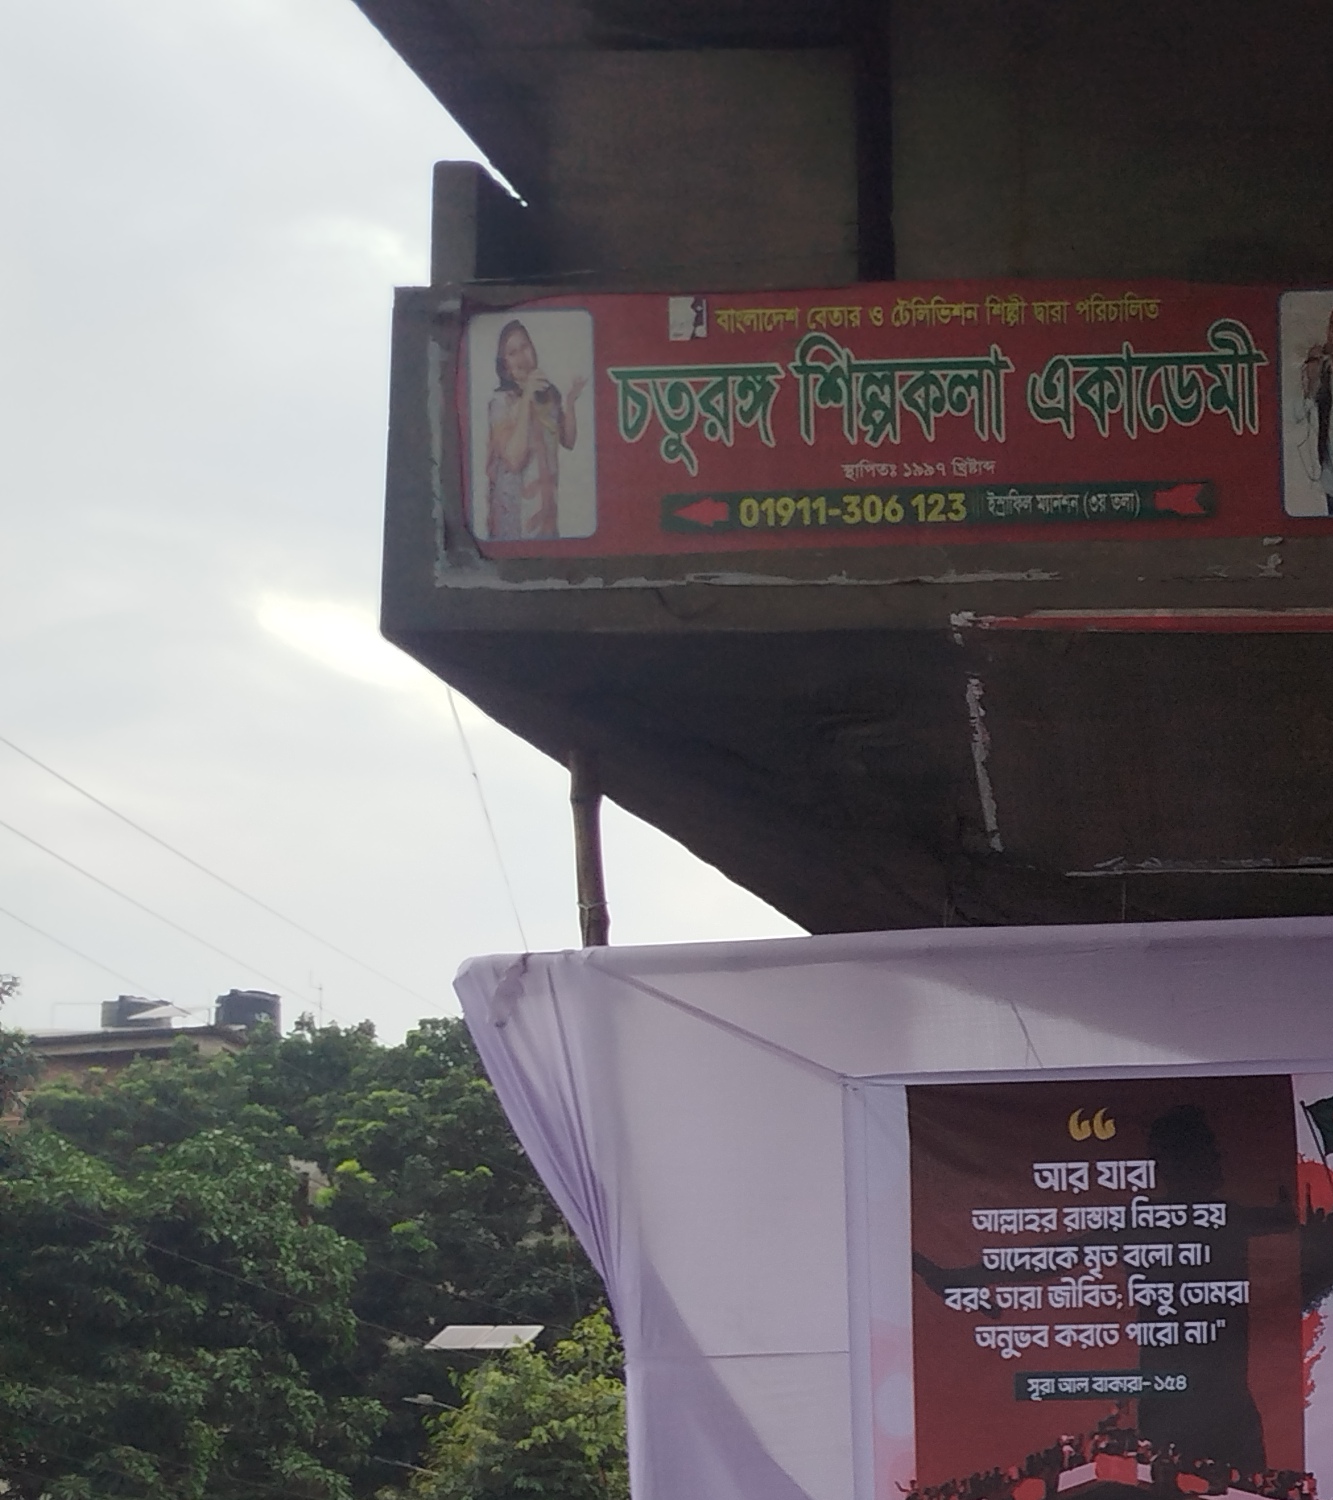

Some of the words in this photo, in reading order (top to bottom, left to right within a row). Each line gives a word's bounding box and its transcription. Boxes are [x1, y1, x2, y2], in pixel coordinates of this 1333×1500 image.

[715, 307, 801, 333] বাংলাদেশ
[807, 306, 862, 330] বেতার
[869, 306, 884, 328] ও
[891, 295, 979, 327] টেলিভিশন
[1032, 300, 1070, 324] দ্বারা
[1075, 292, 1161, 324] পরিচালিত
[607, 362, 786, 478] চতুরঙ্গ
[788, 331, 1015, 448] শিল্পকলা
[1027, 319, 1269, 440] একাডেমী
[903, 461, 946, 477] ১৯৯৭
[739, 493, 904, 527] 01911-306
[910, 492, 967, 522] 123
[1033, 1162, 1089, 1194] আর
[1096, 1159, 1156, 1192] যারা
[972, 1208, 1057, 1235] আল্লাহর
[1064, 1205, 1126, 1234] রাস্তায়
[1131, 1196, 1187, 1229] নিহত
[1193, 1203, 1227, 1230] হয়
[983, 1247, 1078, 1272] তাদেরকে
[1084, 1245, 1118, 1278] মৃত
[1124, 1244, 1172, 1269] বলো
[944, 1287, 991, 1312] বরং
[996, 1287, 1042, 1311] তারা
[1128, 1273, 1178, 1317] কিন্তু
[1179, 1280, 1249, 1306] তোমরা
[975, 1325, 1049, 1358] অনুভব
[1055, 1324, 1120, 1349] করতে
[1125, 1322, 1178, 1347] পারো
[1059, 1378, 1089, 1394] আল
[1154, 1375, 1188, 1391] ১৫৪
